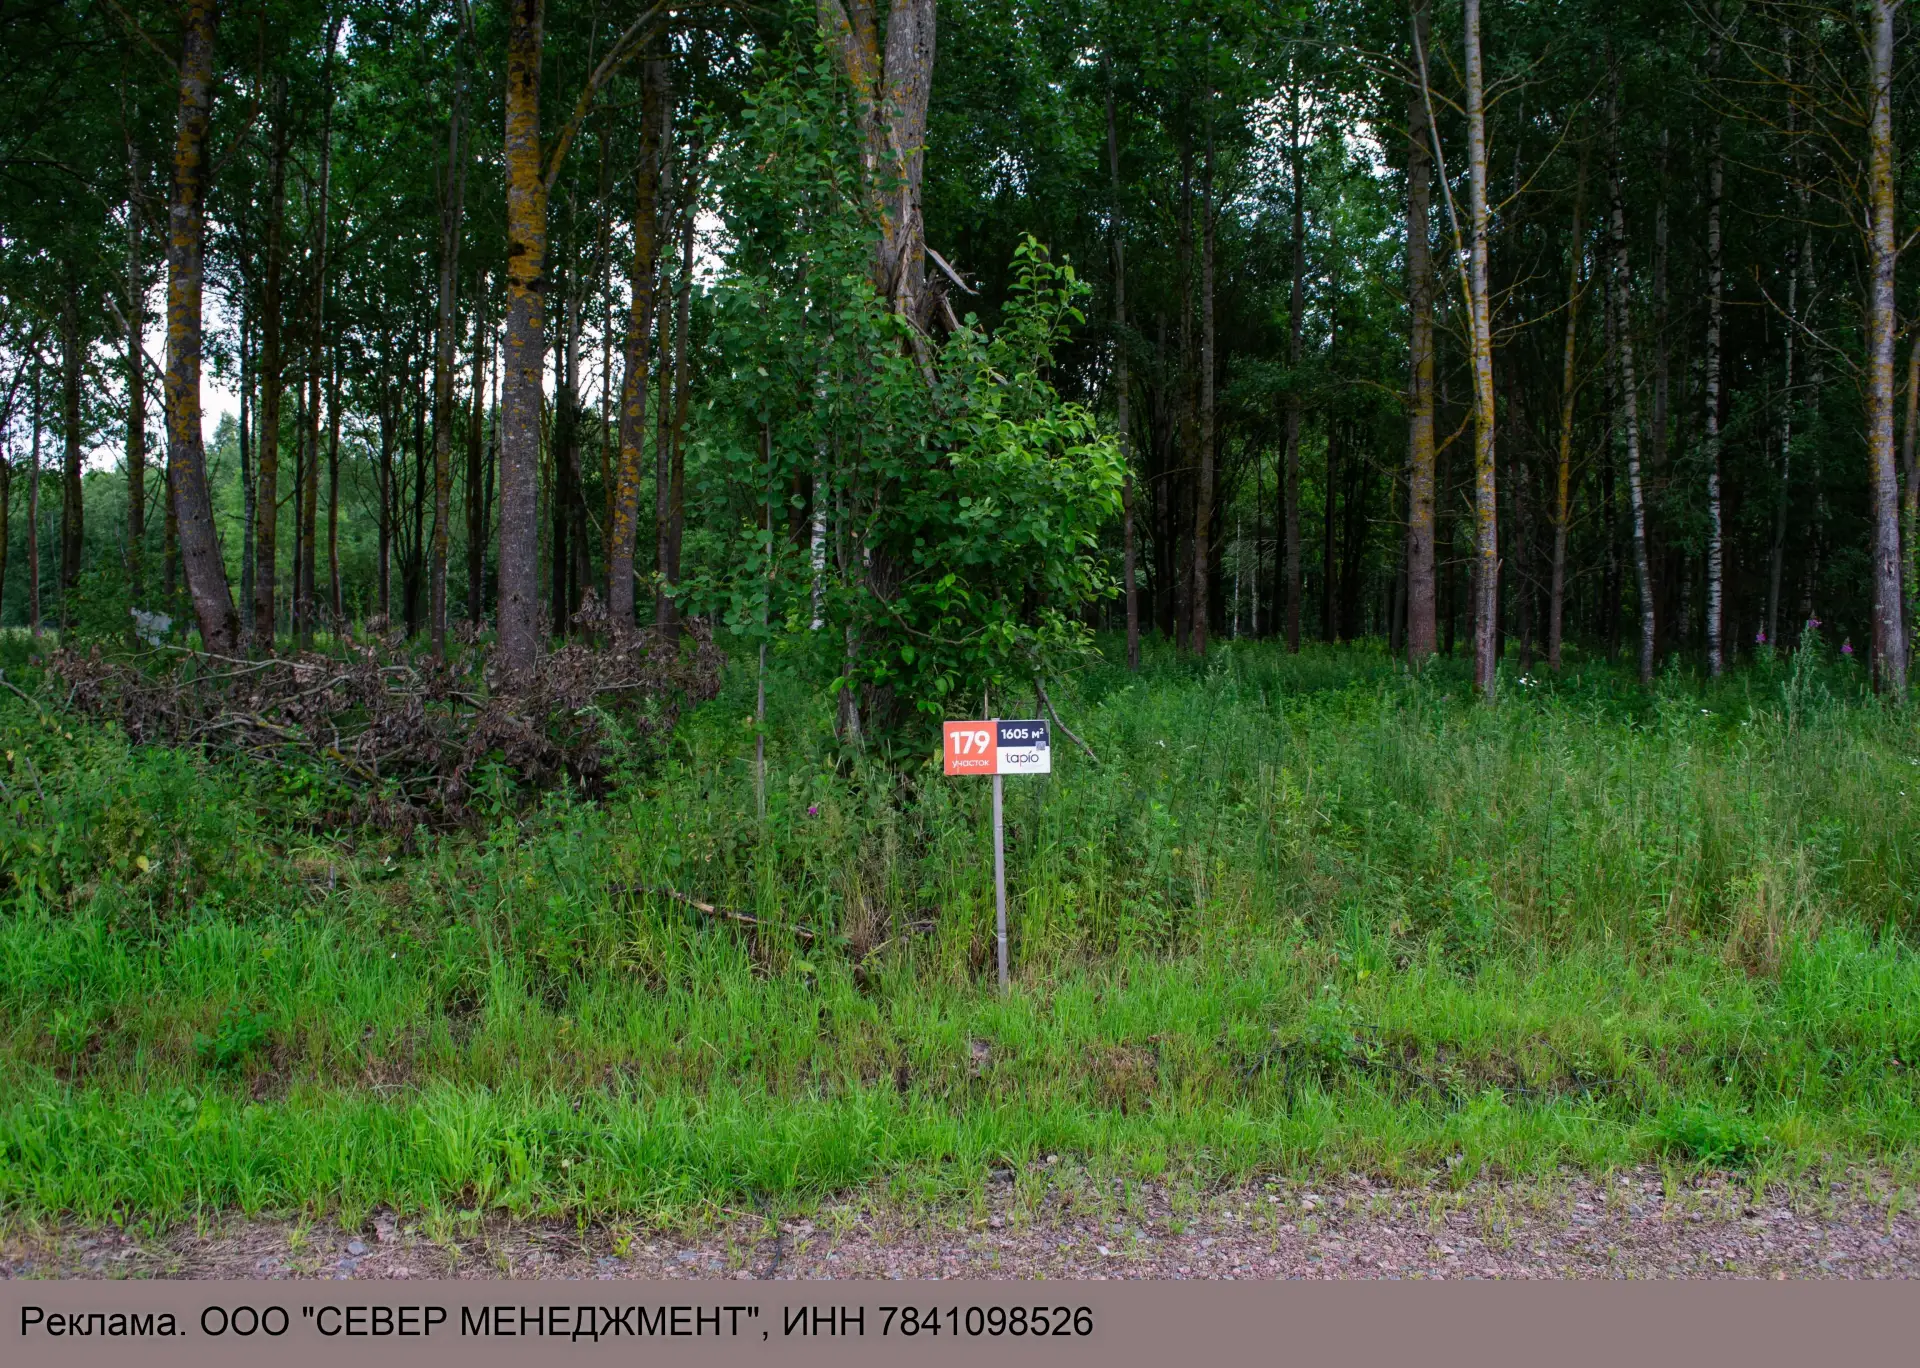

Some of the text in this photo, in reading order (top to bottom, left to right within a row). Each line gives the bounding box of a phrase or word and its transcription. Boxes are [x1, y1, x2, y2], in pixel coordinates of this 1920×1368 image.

[1001, 728, 1029, 739] 1605
[949, 730, 991, 755] 179
[952, 759, 990, 769] участок
